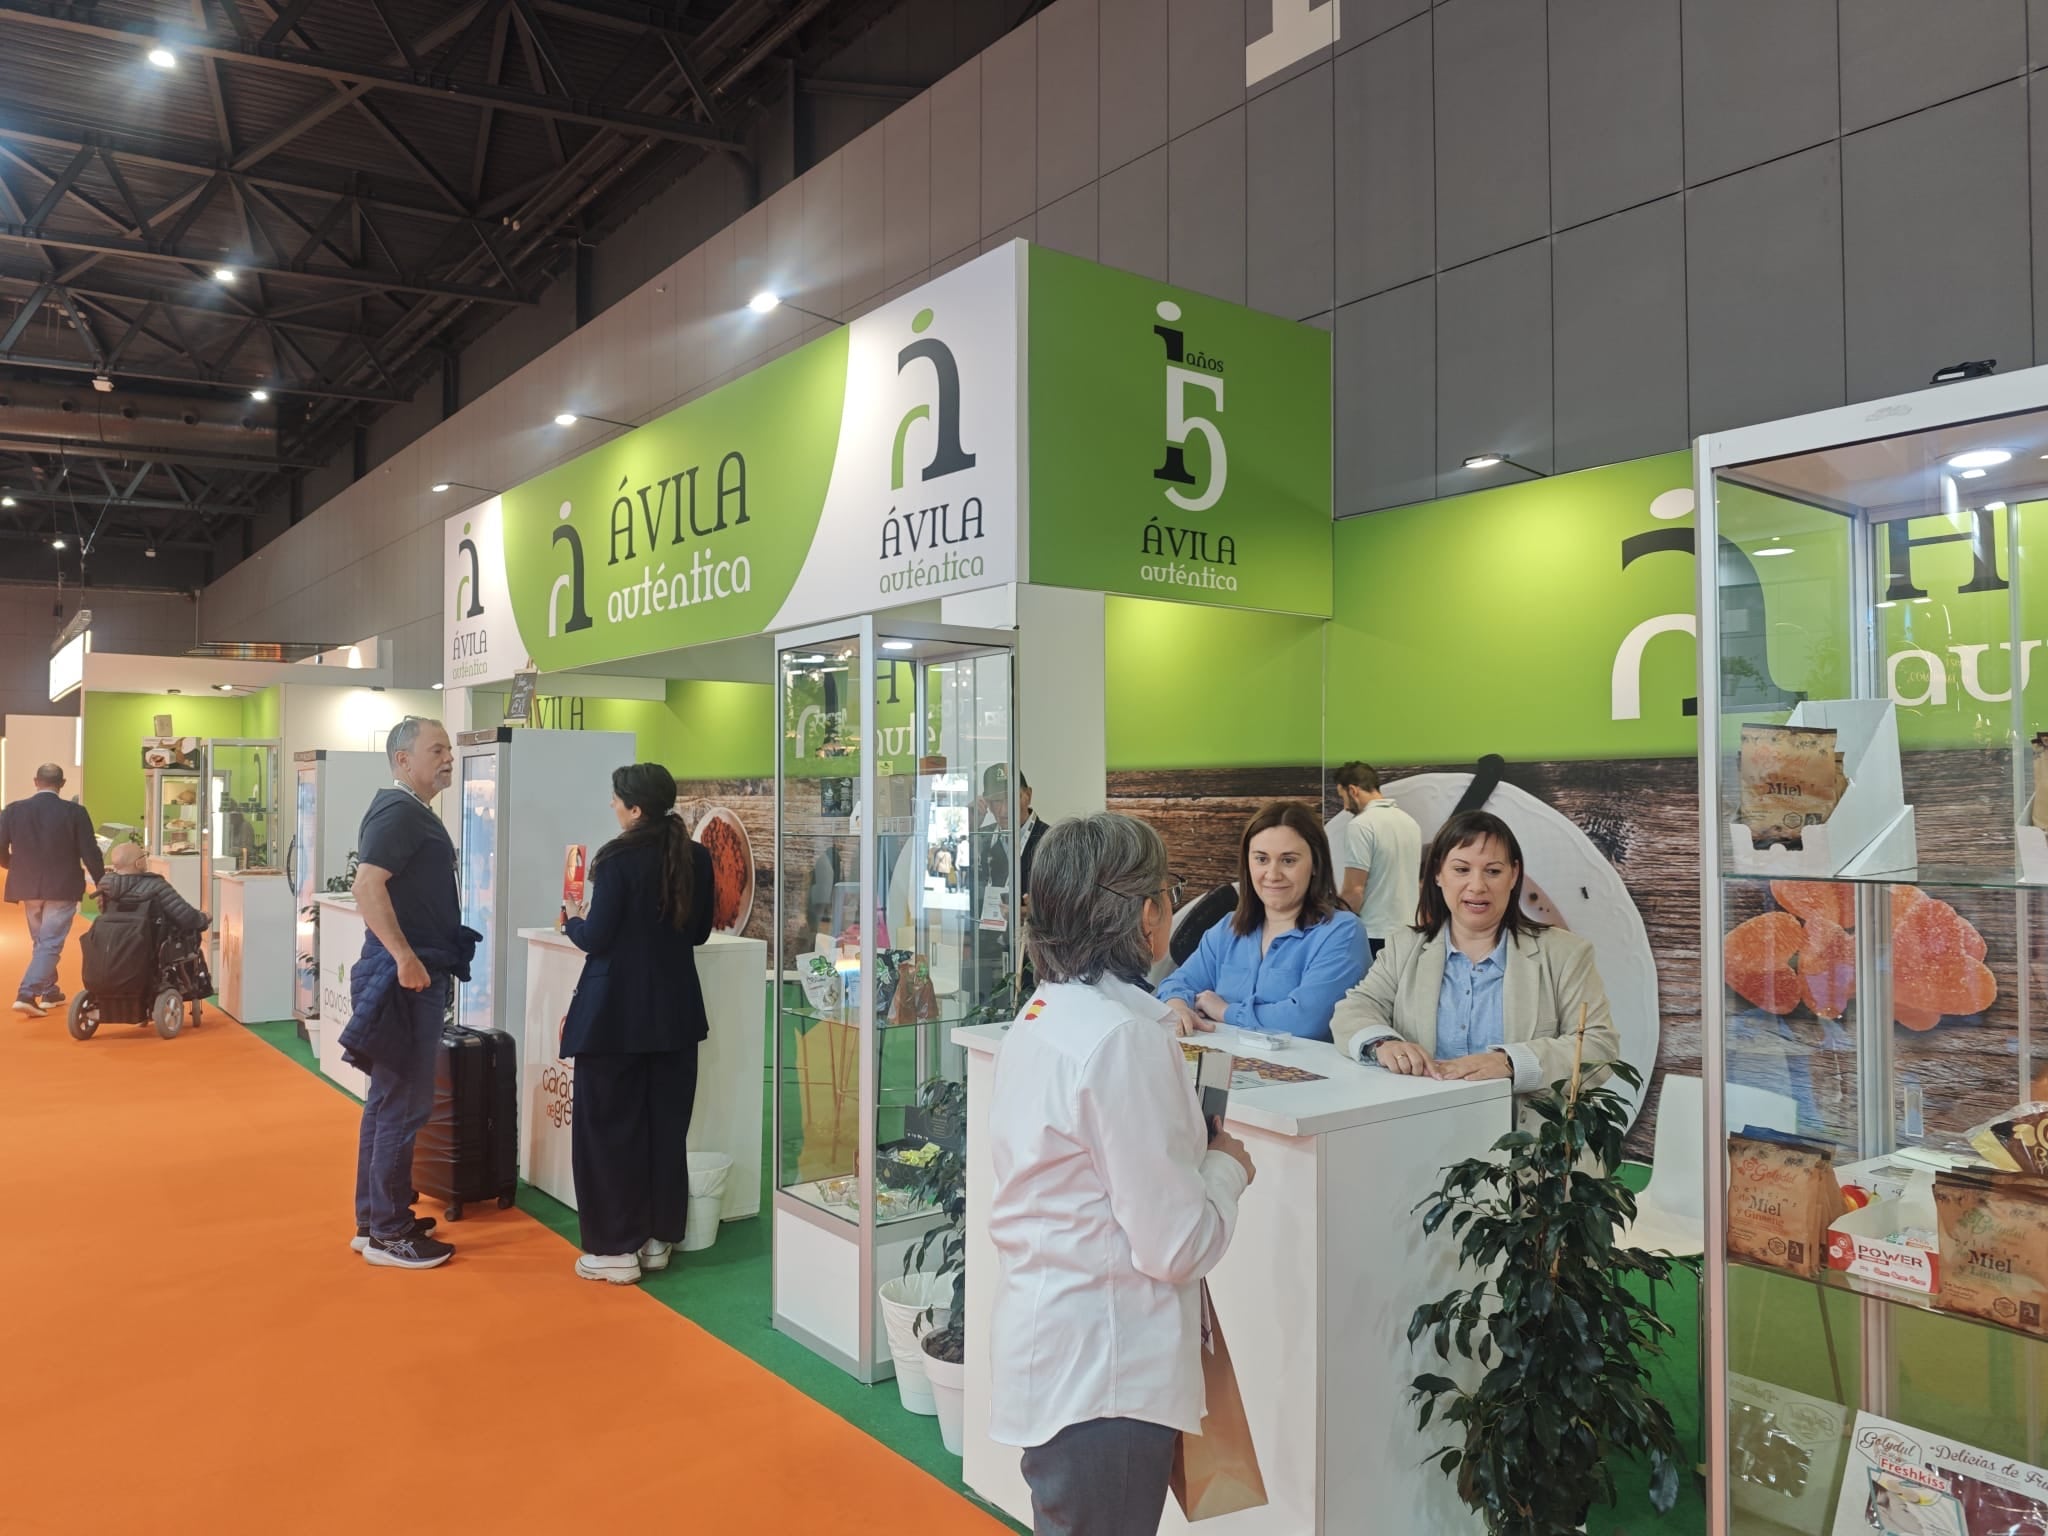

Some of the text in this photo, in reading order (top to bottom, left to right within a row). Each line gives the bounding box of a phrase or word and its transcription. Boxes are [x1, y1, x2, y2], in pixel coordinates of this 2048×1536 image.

[1186, 351, 1225, 374] años
[607, 451, 751, 566] ÁVILA
[879, 496, 985, 560] ÁVILA
[1140, 516, 1238, 566] ÁVILA
[607, 547, 752, 624] auténtica
[879, 550, 985, 594] auténtica
[1140, 562, 1238, 592] auténtica
[452, 630, 488, 660] ÁVILA
[452, 660, 488, 680] auténtica
[1766, 782, 1802, 798] Miel
[1749, 1195, 1782, 1217] Miel
[1858, 1244, 1923, 1268] POWER
[1968, 1249, 2012, 1274] Miel
[1859, 1431, 1917, 1458] Golydul
[1880, 1458, 1946, 1490] Freshkiss
[2001, 1463, 2020, 1478] de
